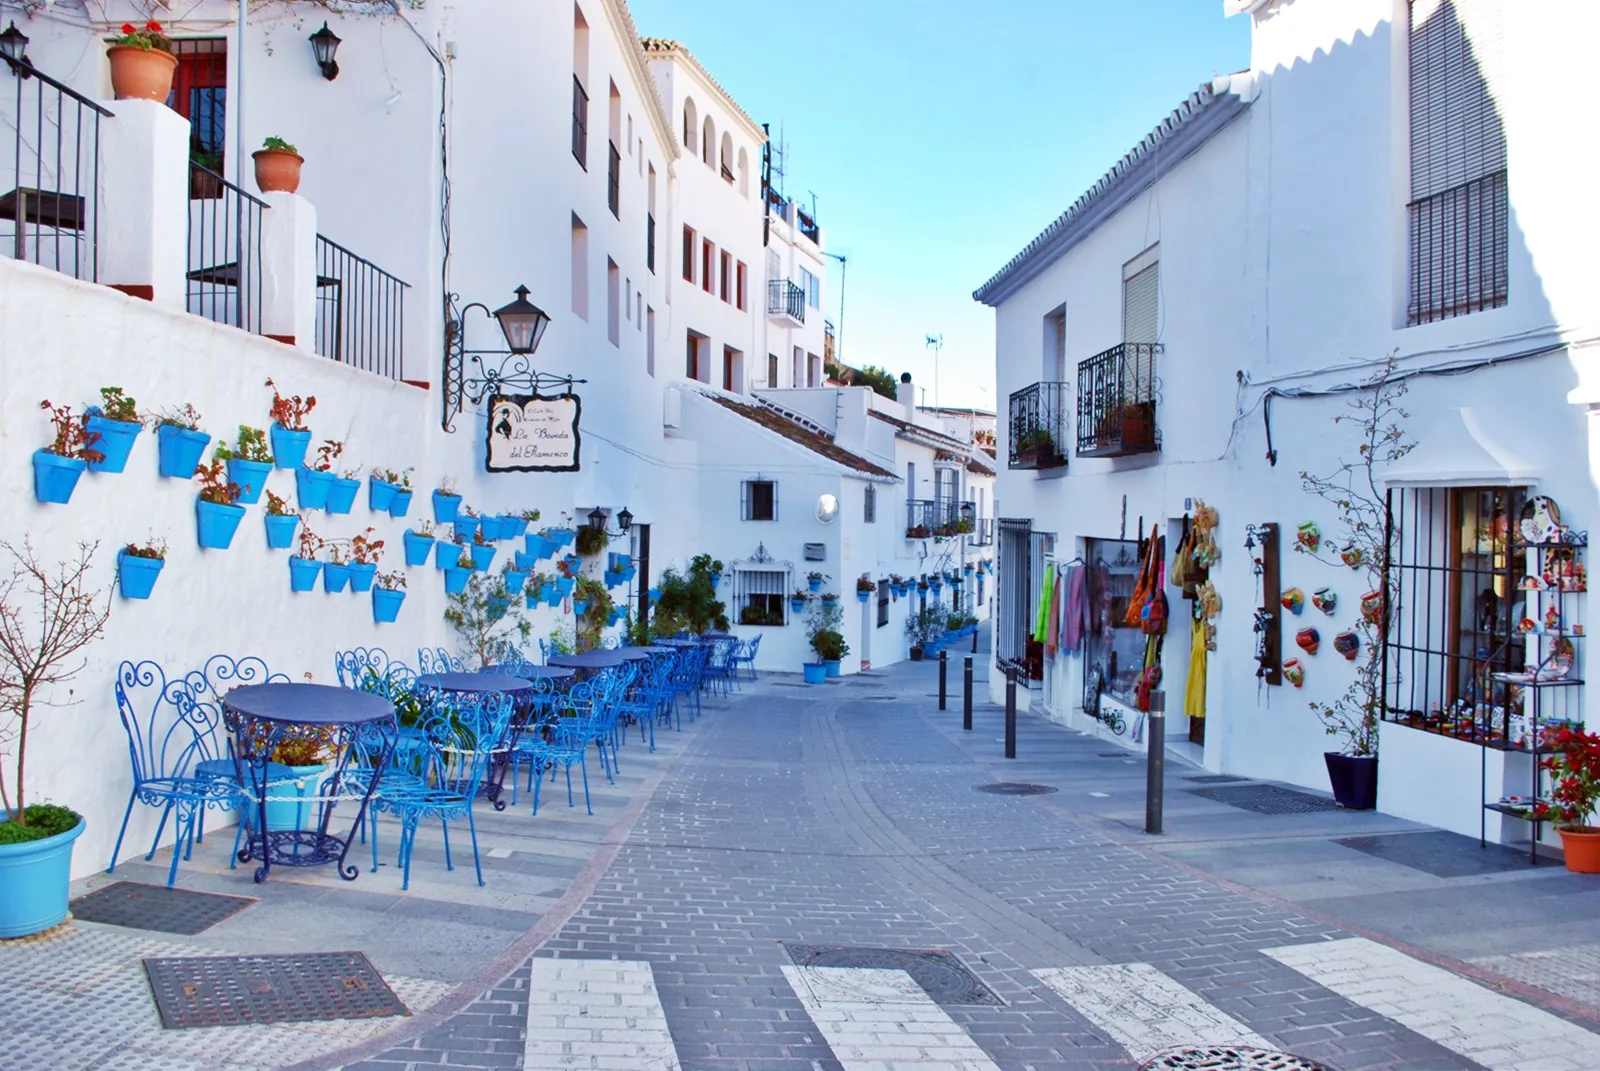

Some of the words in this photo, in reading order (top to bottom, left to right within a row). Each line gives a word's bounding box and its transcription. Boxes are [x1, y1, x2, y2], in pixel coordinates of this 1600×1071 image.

[513, 428, 528, 439] La
[509, 446, 522, 458] del
[523, 444, 569, 458] Flamenco
